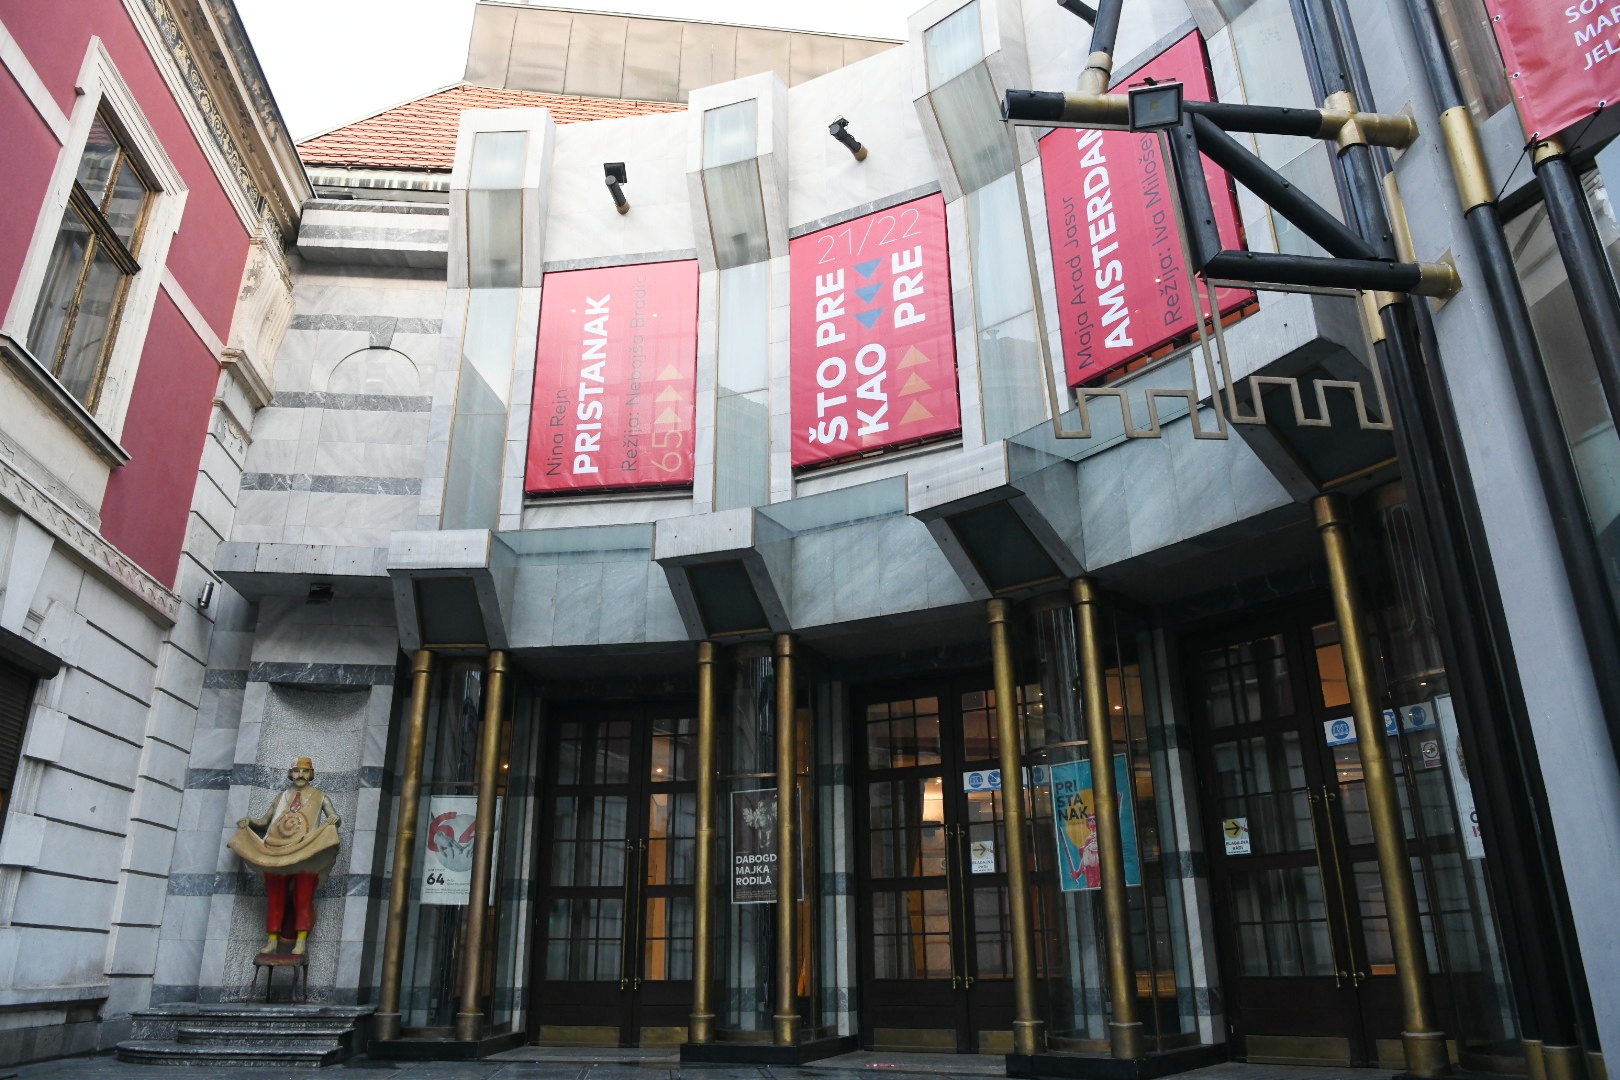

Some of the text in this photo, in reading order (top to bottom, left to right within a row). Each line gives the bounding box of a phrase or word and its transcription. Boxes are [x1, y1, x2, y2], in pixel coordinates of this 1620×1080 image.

[1565, 0, 1604, 24] SO
[817, 208, 921, 264] 21/22
[1152, 210, 1169, 247] Iva
[891, 244, 926, 329] PRE
[1062, 197, 1095, 370] Maja Arad Jasur
[1159, 247, 1183, 327] Režija:
[572, 293, 611, 475] PRISTANAK
[625, 334, 646, 406] Nebojša
[808, 268, 849, 444] ŠTO PRE
[854, 343, 889, 437] KAO
[546, 388, 571, 476] Nina Rejn
[620, 411, 641, 472] Režija:
[651, 429, 683, 473] 65
[1056, 779, 1077, 795] PRI
[1057, 793, 1083, 808] STA
[1058, 806, 1088, 821] NAK
[426, 872, 445, 886] 64
[736, 866, 770, 875] MAJKA
[736, 877, 772, 885] RODILA
